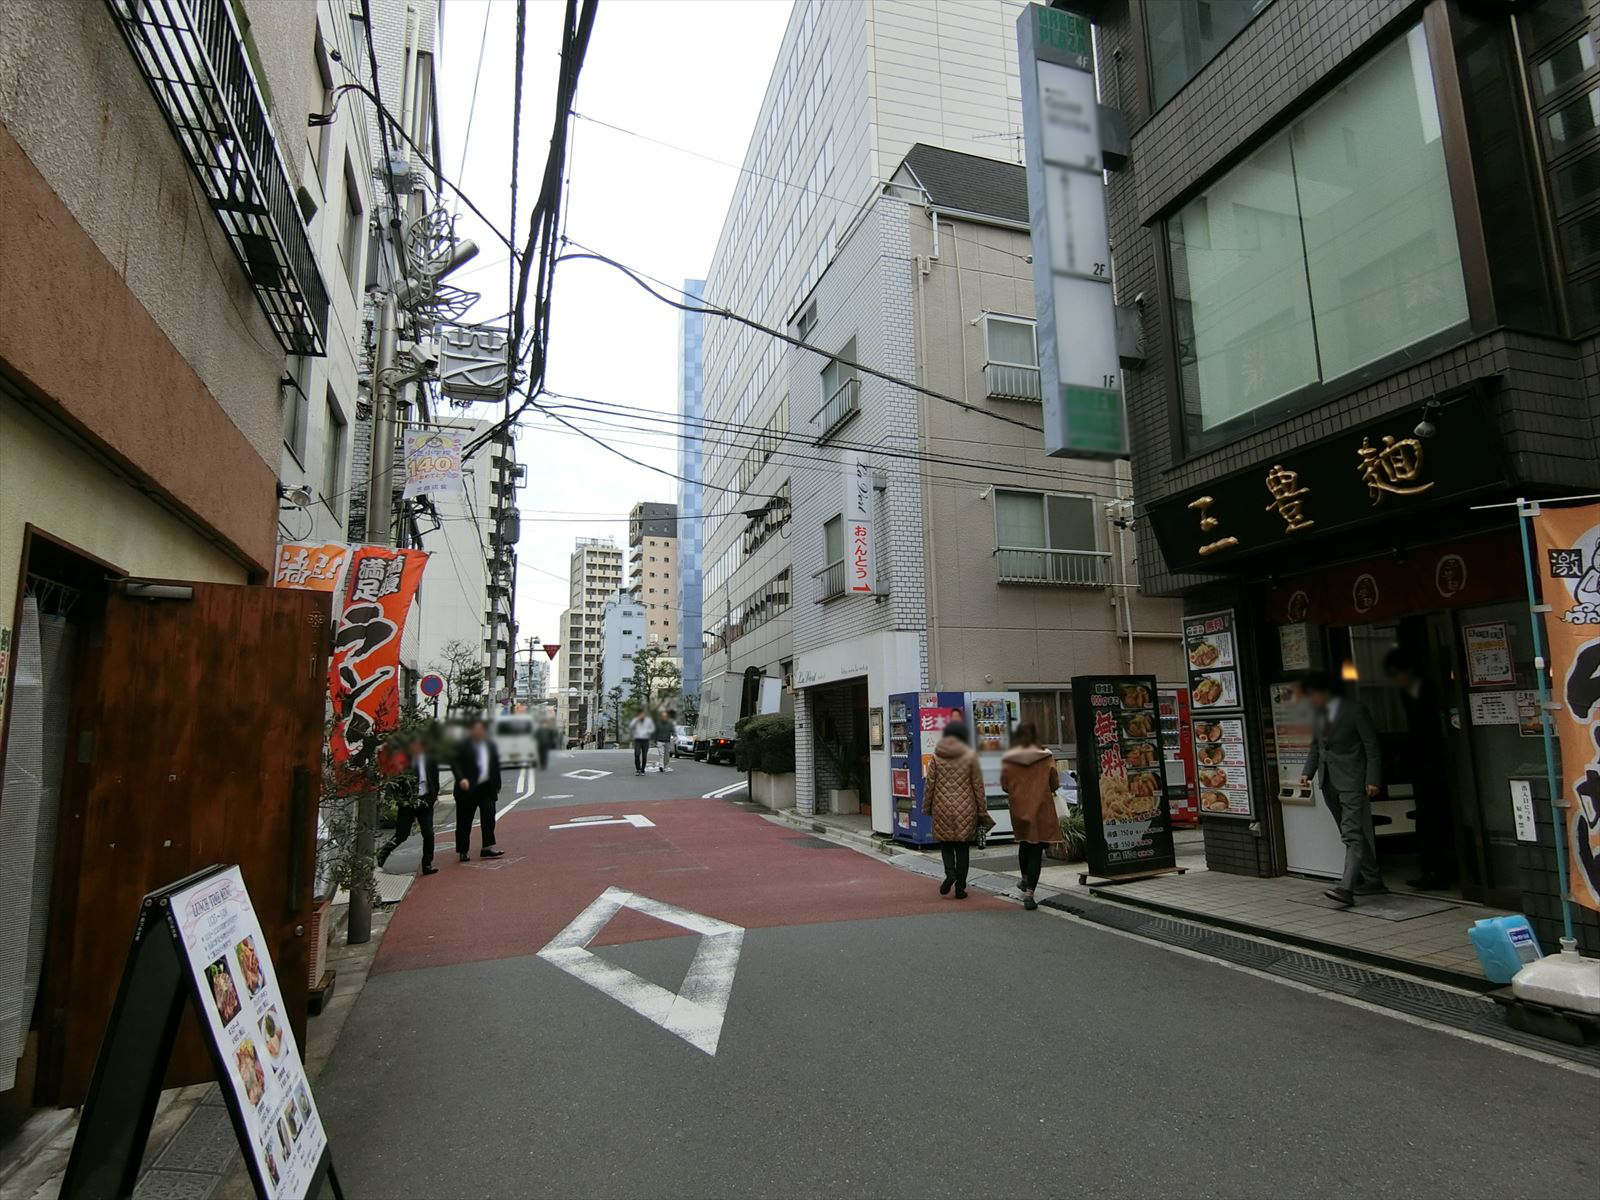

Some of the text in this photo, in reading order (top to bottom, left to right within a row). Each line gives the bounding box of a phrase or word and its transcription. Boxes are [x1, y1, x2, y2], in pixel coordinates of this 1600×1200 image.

[1076, 55, 1089, 69] 4F
[1093, 262, 1106, 277] 2F
[1103, 374, 1115, 389] 1F
[408, 456, 453, 478] 140
[854, 525, 868, 579] おべんとう
